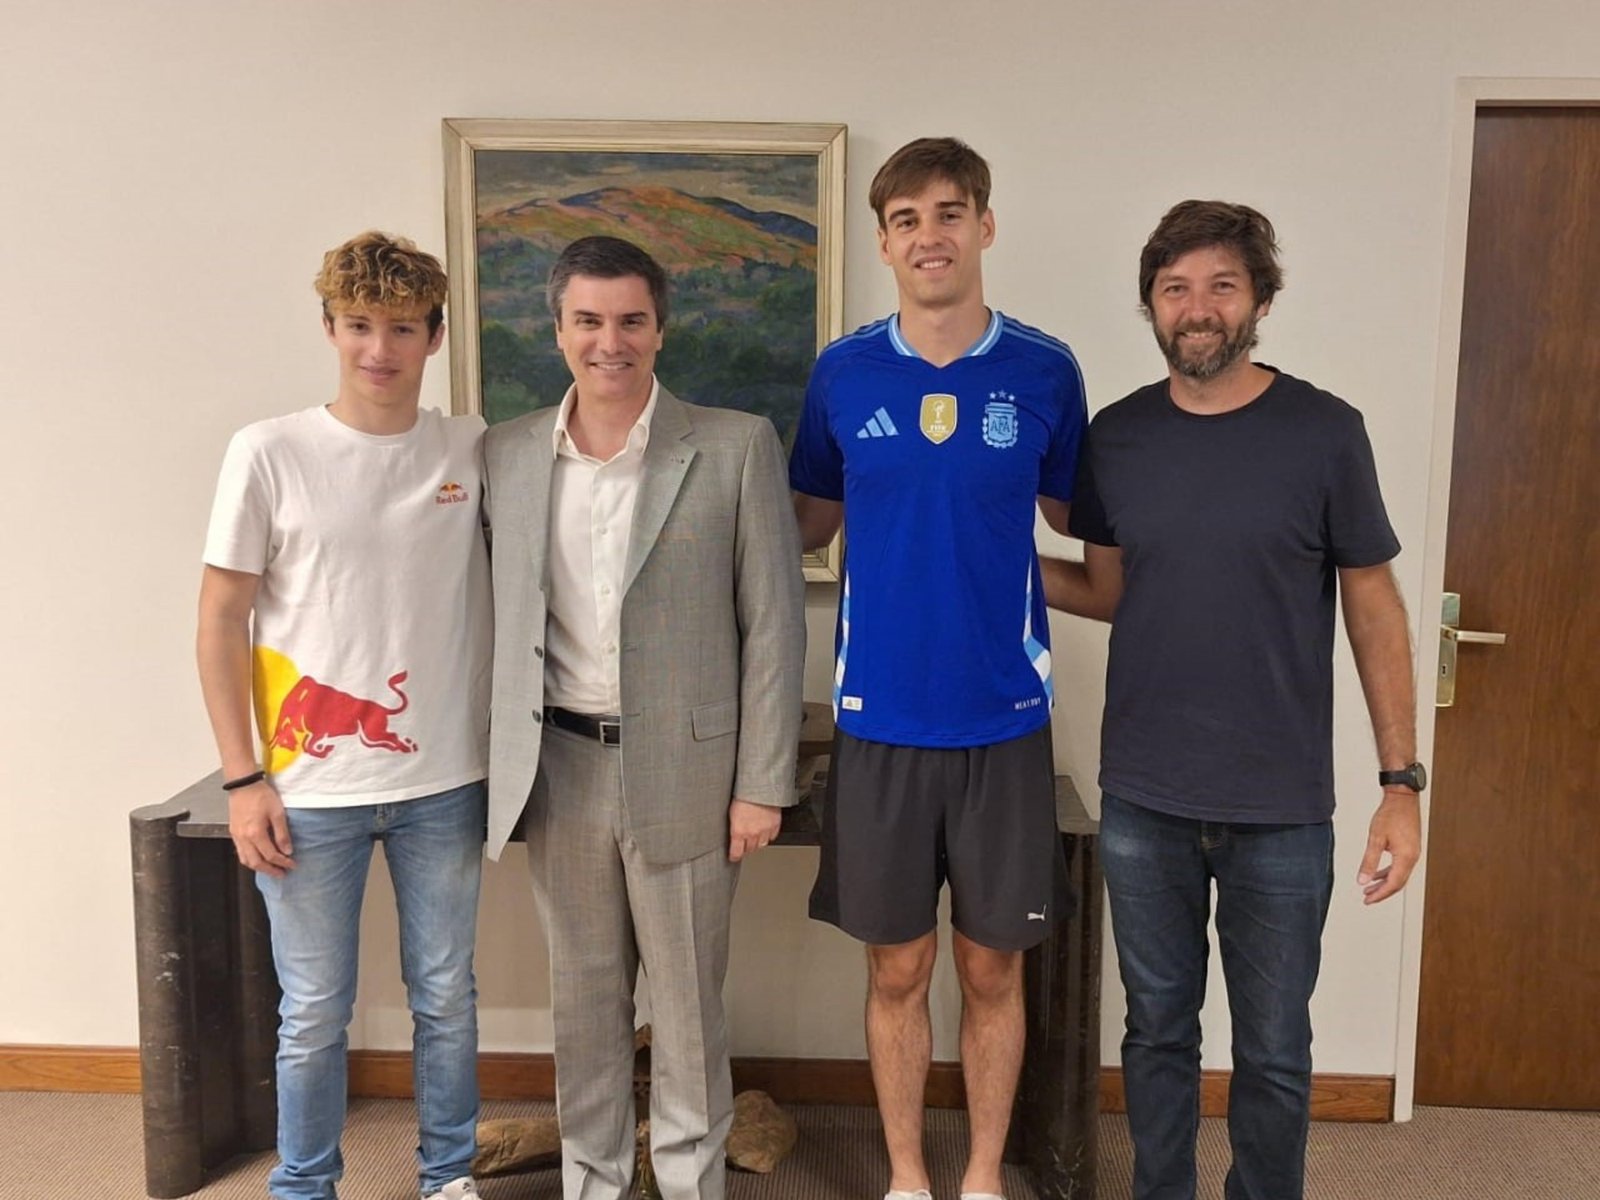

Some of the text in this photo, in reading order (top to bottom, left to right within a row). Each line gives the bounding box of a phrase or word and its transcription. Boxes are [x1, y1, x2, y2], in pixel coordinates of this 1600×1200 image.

[990, 415, 1010, 436] AFA
[436, 493, 469, 504] Red Bull
